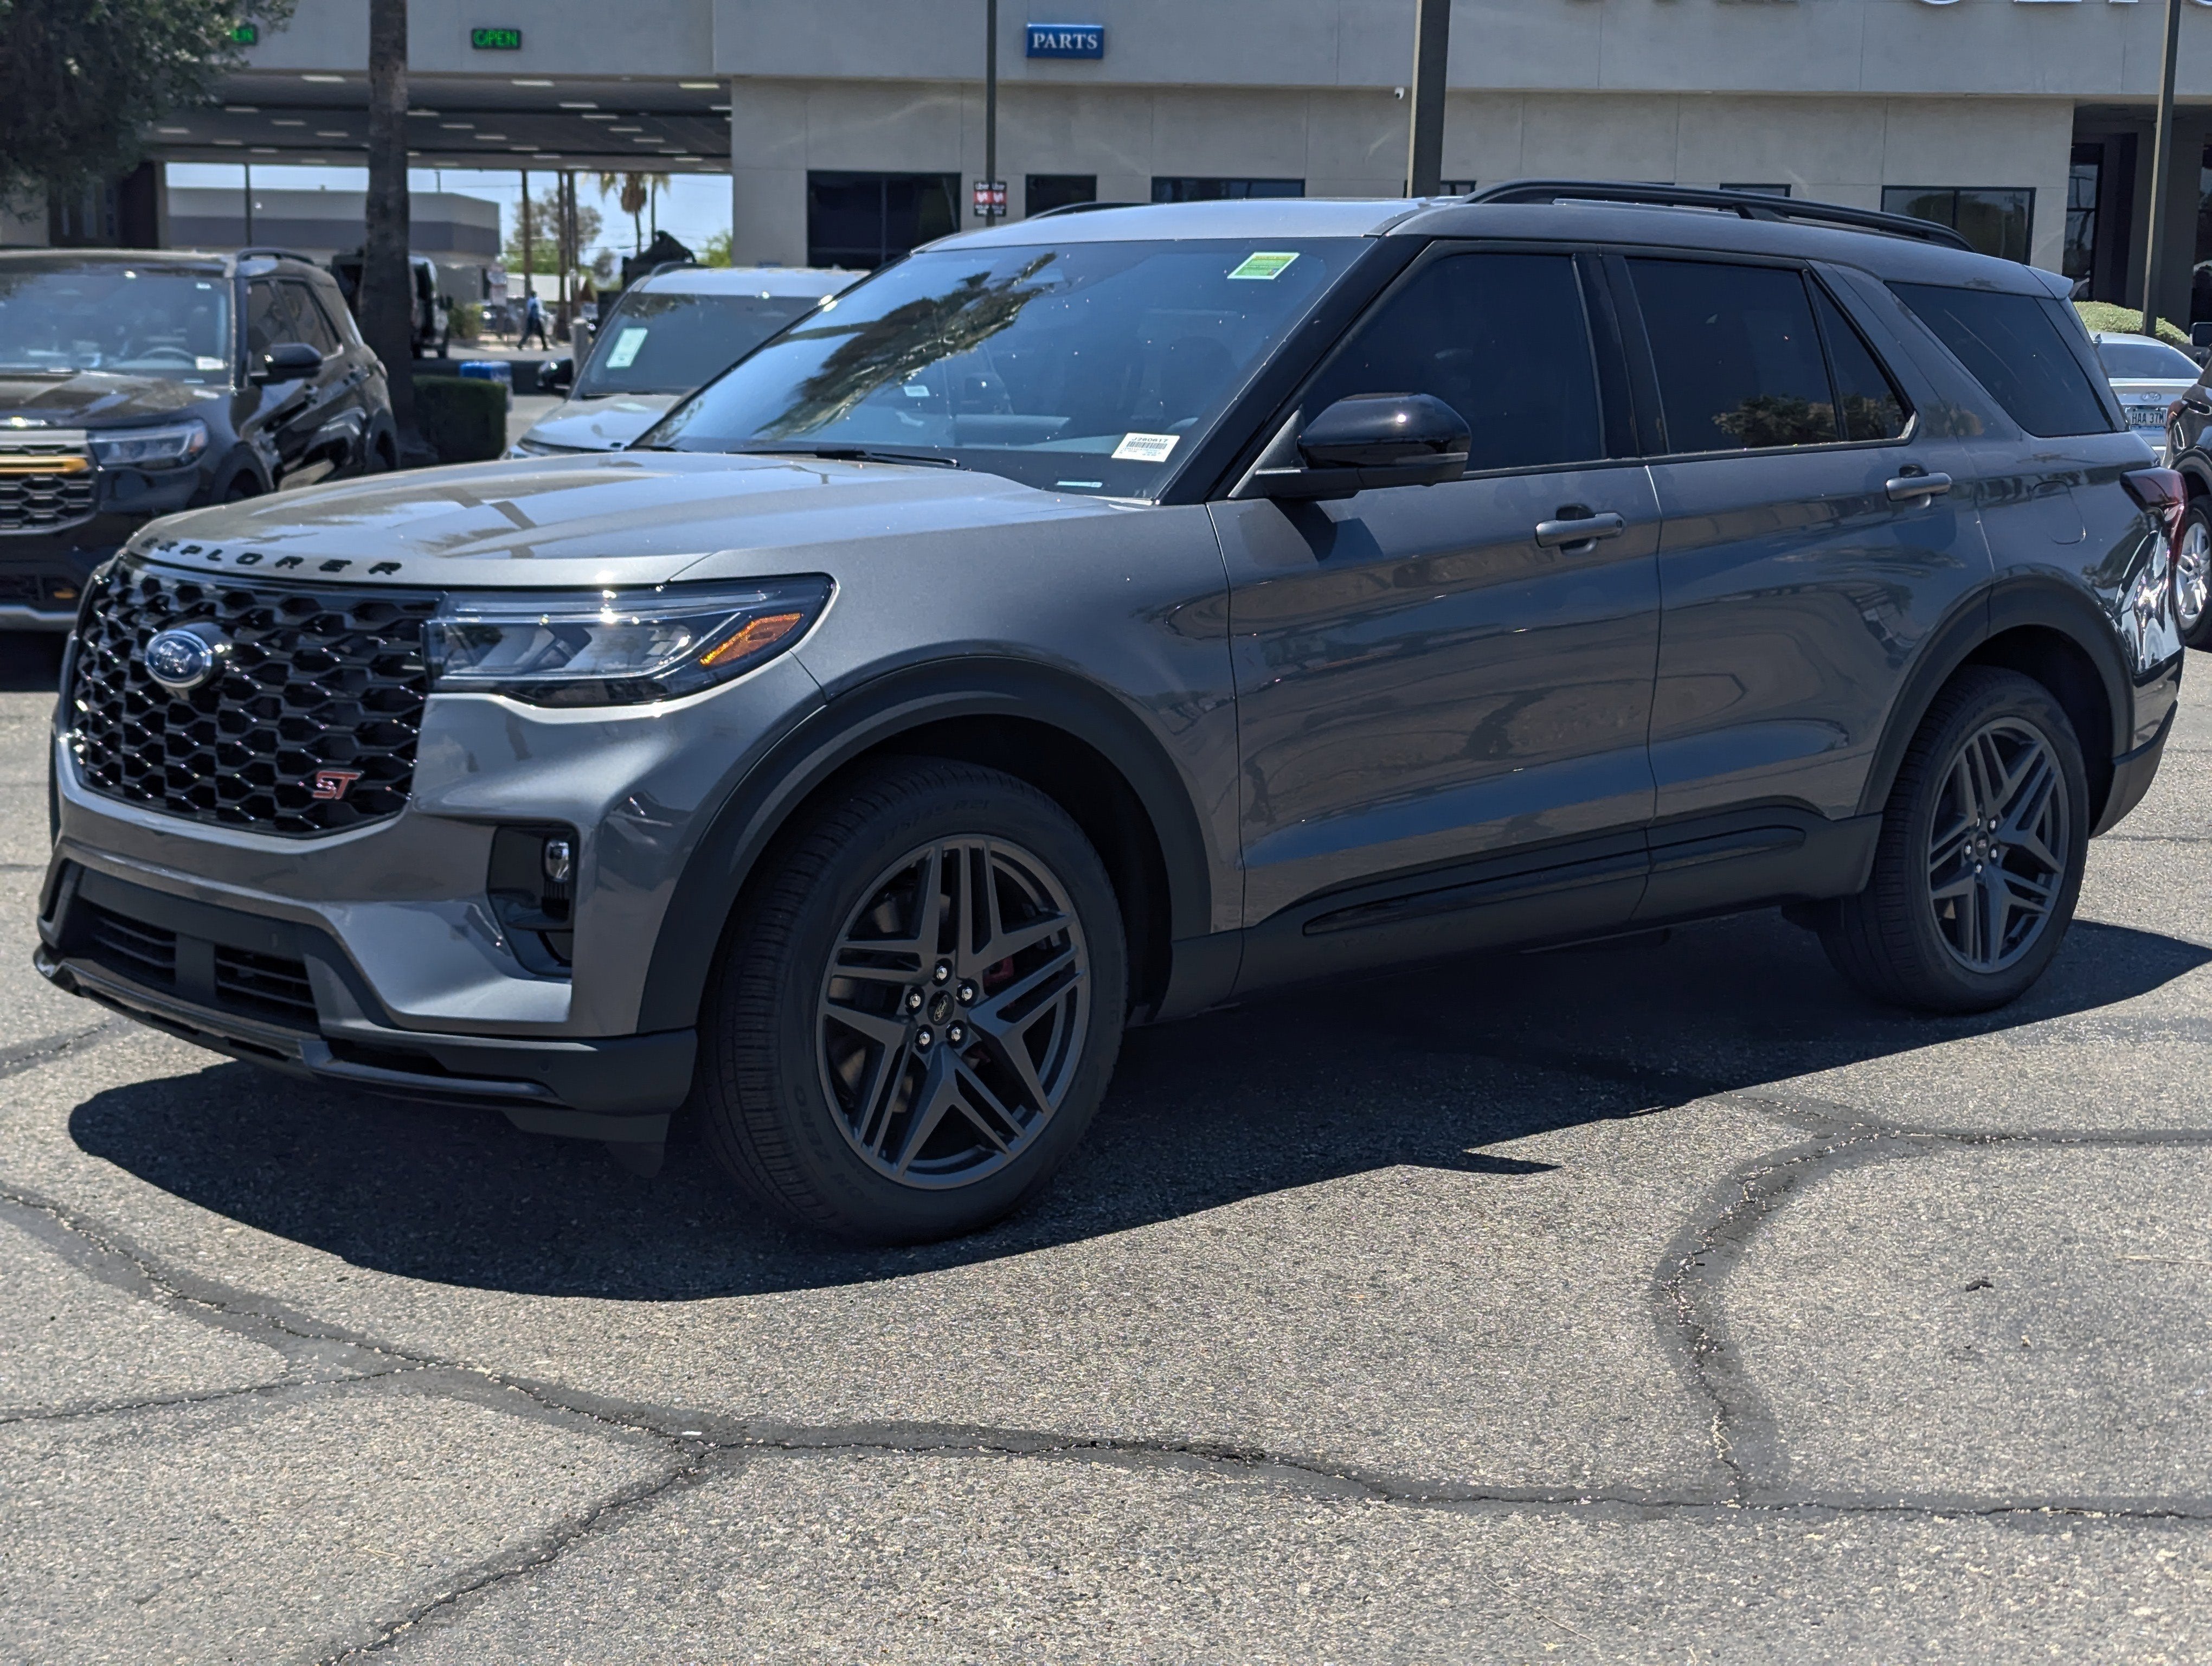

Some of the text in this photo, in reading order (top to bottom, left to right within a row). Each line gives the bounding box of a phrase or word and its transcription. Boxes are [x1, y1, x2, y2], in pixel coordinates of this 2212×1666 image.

[474, 30, 517, 46] OPEN
[1033, 33, 1098, 49] PARTS
[140, 537, 402, 575] EXPLORER
[313, 770, 362, 799] ST
